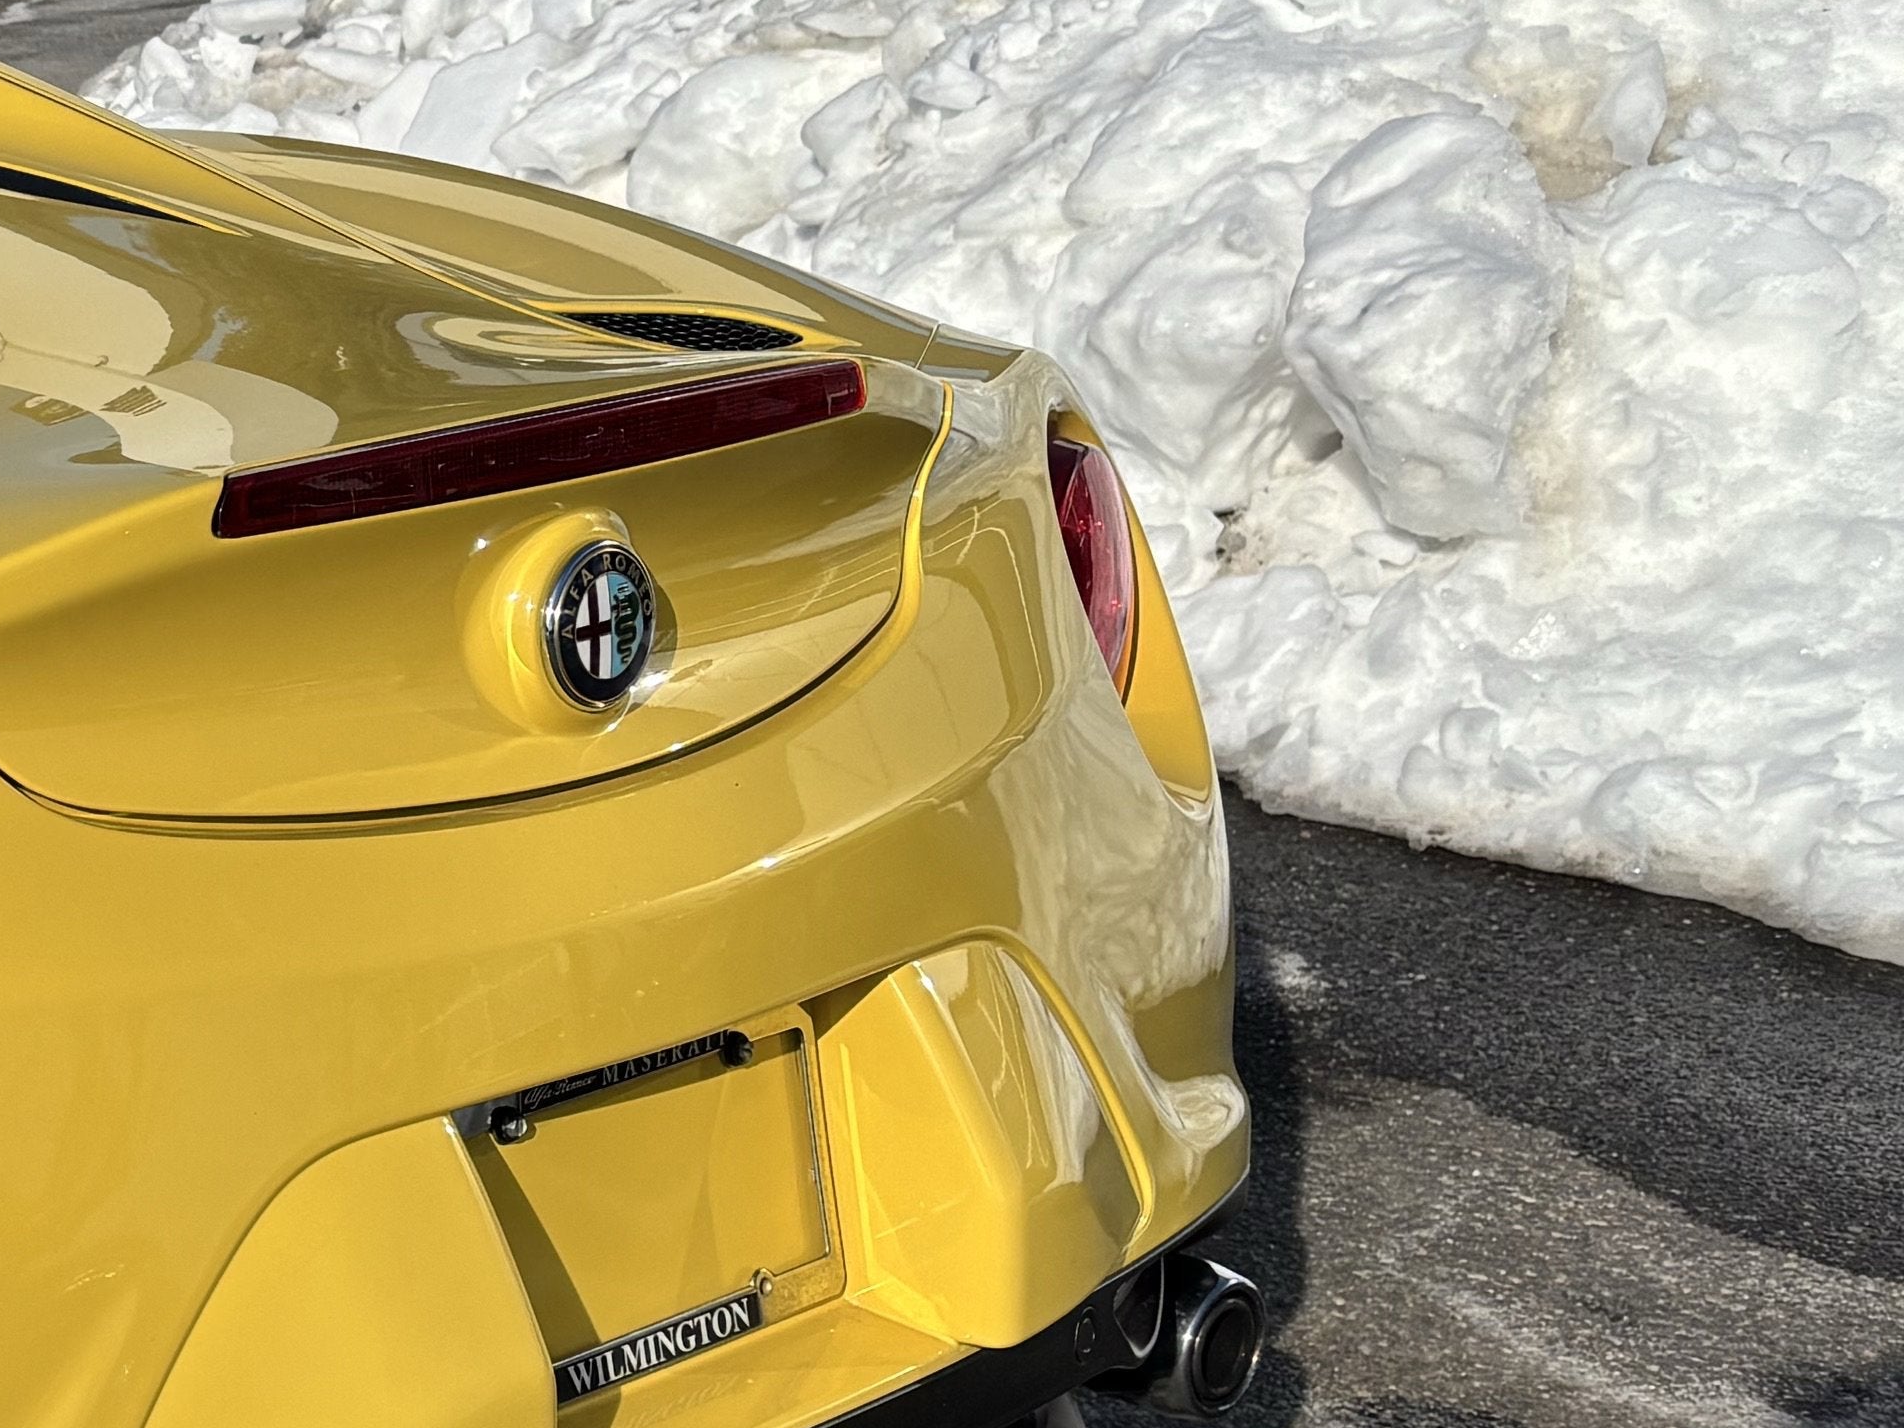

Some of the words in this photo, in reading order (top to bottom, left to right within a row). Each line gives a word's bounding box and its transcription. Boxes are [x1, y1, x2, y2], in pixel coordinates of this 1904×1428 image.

[561, 572, 594, 639] ALFA
[602, 553, 653, 616] ROMEO
[568, 1298, 751, 1394] WILMINGTON
